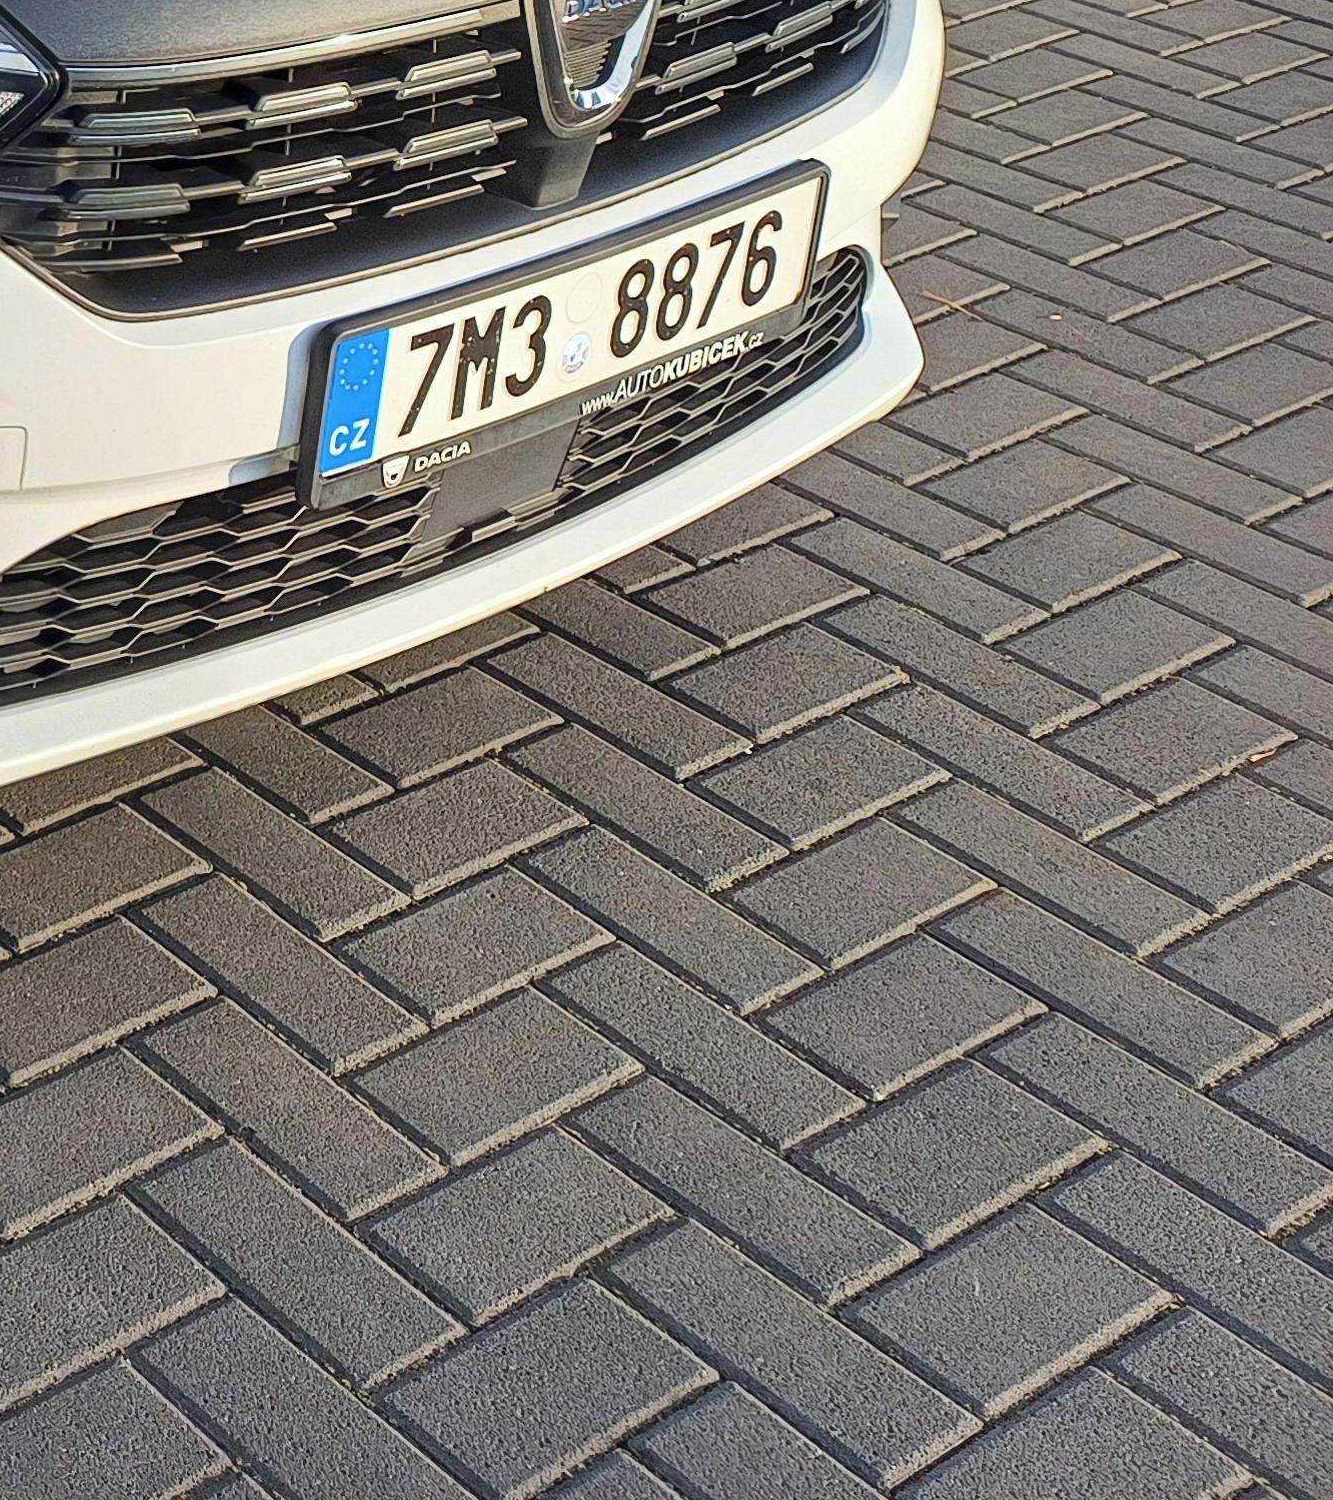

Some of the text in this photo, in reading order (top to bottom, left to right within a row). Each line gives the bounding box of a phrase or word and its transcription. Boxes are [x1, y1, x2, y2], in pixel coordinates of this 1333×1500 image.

[397, 210, 783, 439] 7M3 8876
[328, 416, 370, 455] CZ
[413, 441, 472, 471] DACIA
